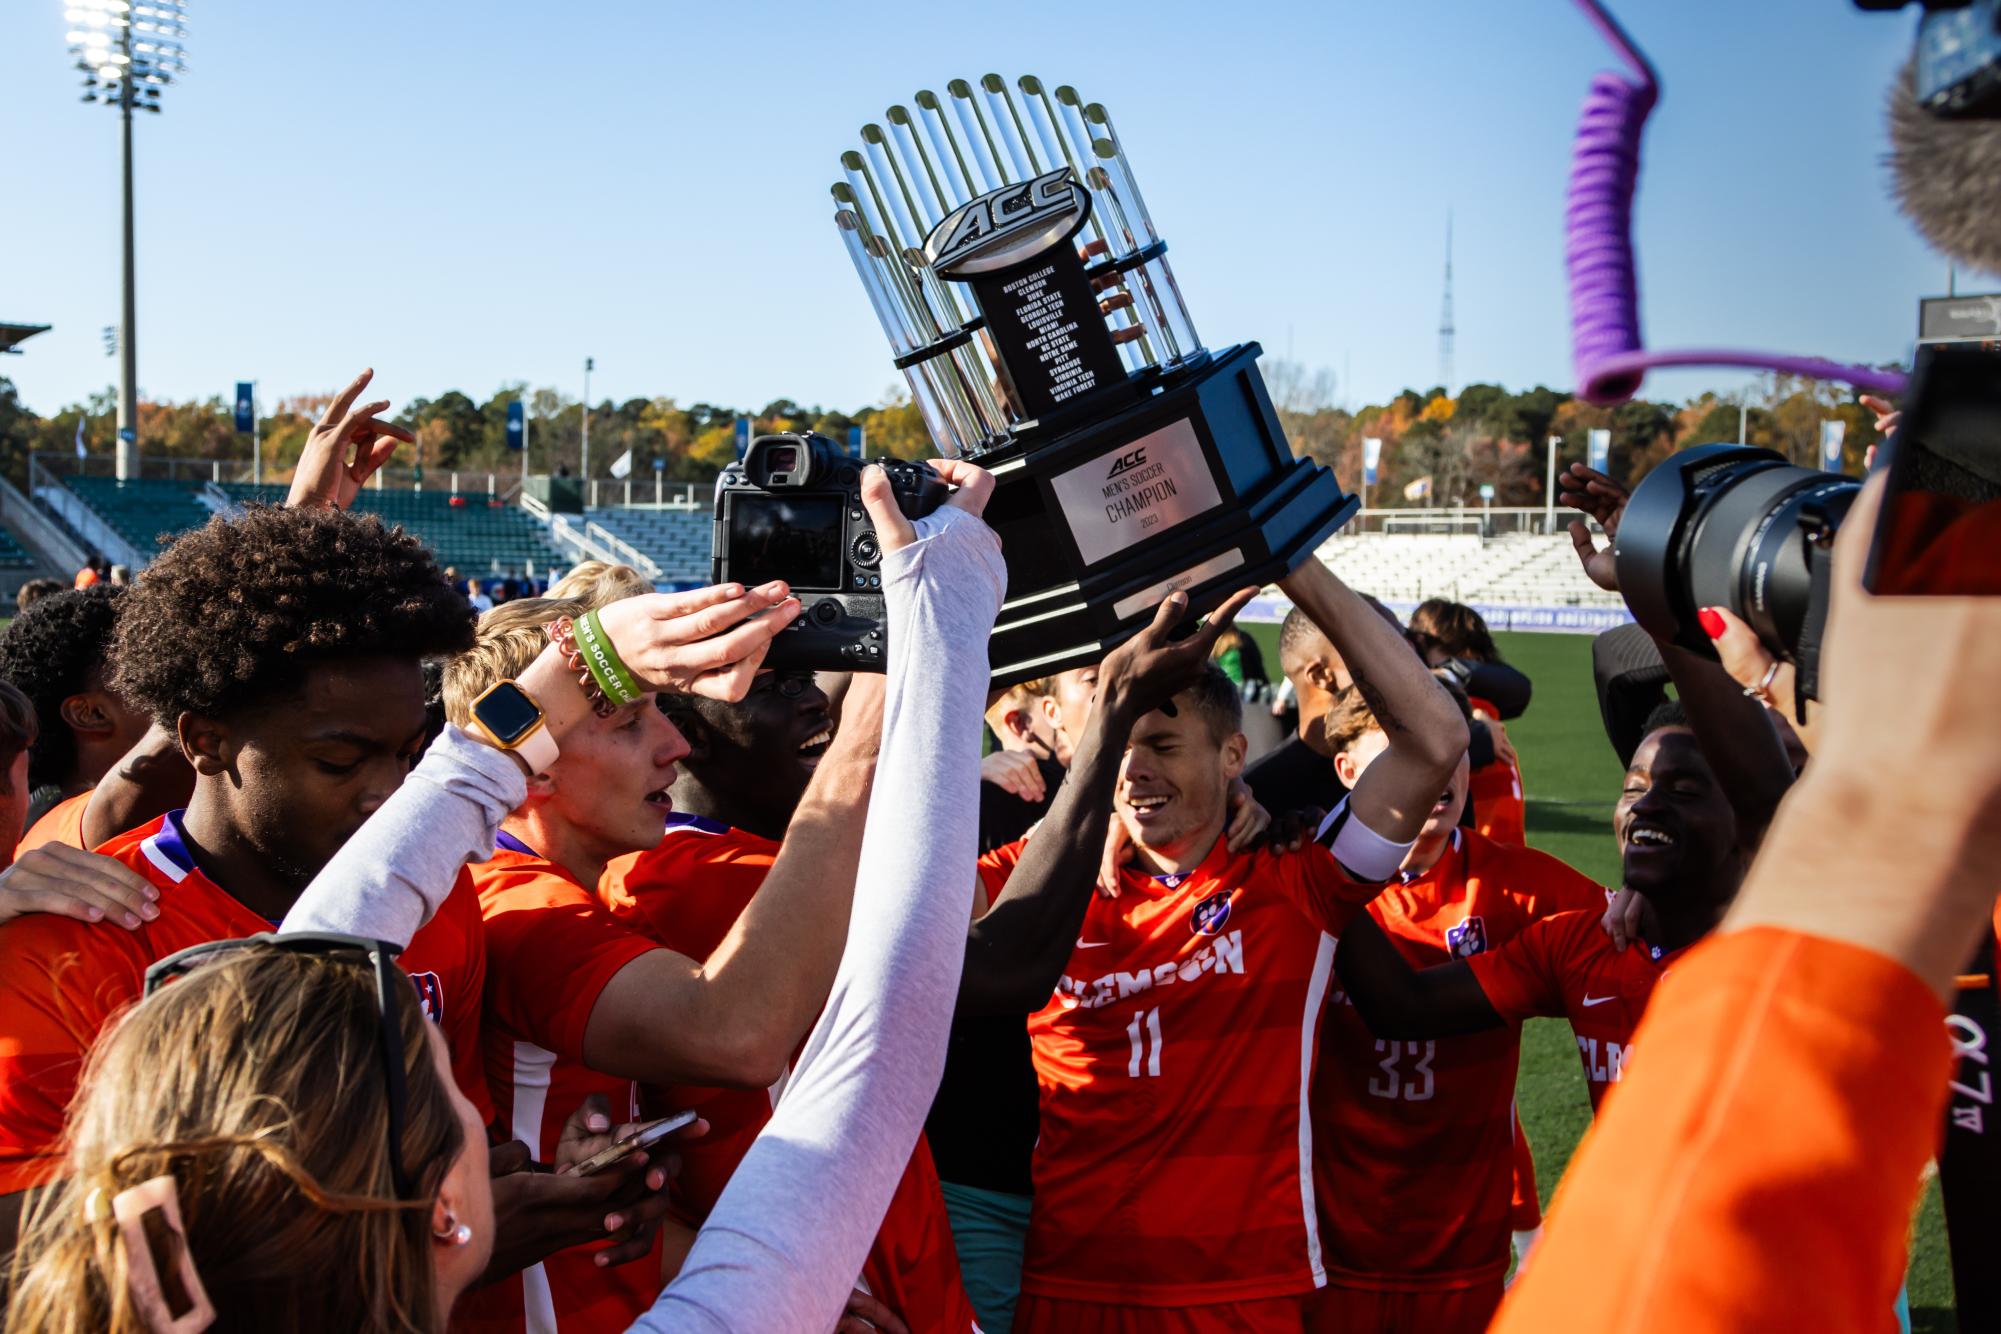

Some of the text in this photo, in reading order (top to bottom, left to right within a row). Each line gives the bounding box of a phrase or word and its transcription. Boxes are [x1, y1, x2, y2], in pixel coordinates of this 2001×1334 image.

[934, 166, 1078, 269] ACC
[1003, 265, 1056, 294] BOSTON COLLEGE
[1018, 279, 1047, 296] CLEMSON
[1016, 291, 1062, 316] FLORIDA STATE
[1027, 291, 1044, 302] DUKE
[1020, 300, 1064, 324] GEORGIA TECH
[1028, 309, 1063, 330] LOUISVILLE
[1026, 322, 1079, 349] NORTH CAROLINA
[1039, 321, 1059, 334] MIAMI
[1039, 340, 1078, 362] NOTRE DAME
[1041, 334, 1070, 352] NC STATE
[1049, 358, 1081, 376] SYRACUSE
[1055, 353, 1070, 365] PITT
[1049, 371, 1094, 395] VIRGINIA TECH
[1054, 366, 1082, 384] VIRGINIA
[1054, 379, 1096, 402] WAKE FOREST
[1107, 447, 1147, 480] ACC
[1102, 462, 1165, 499] MEN'S SOCCER
[1105, 478, 1177, 524] CHAMPION
[1140, 515, 1159, 528] 2023
[591, 644, 622, 690] SOCCER
[1126, 1006, 1162, 1077] 11
[1368, 1039, 1435, 1101] 33
